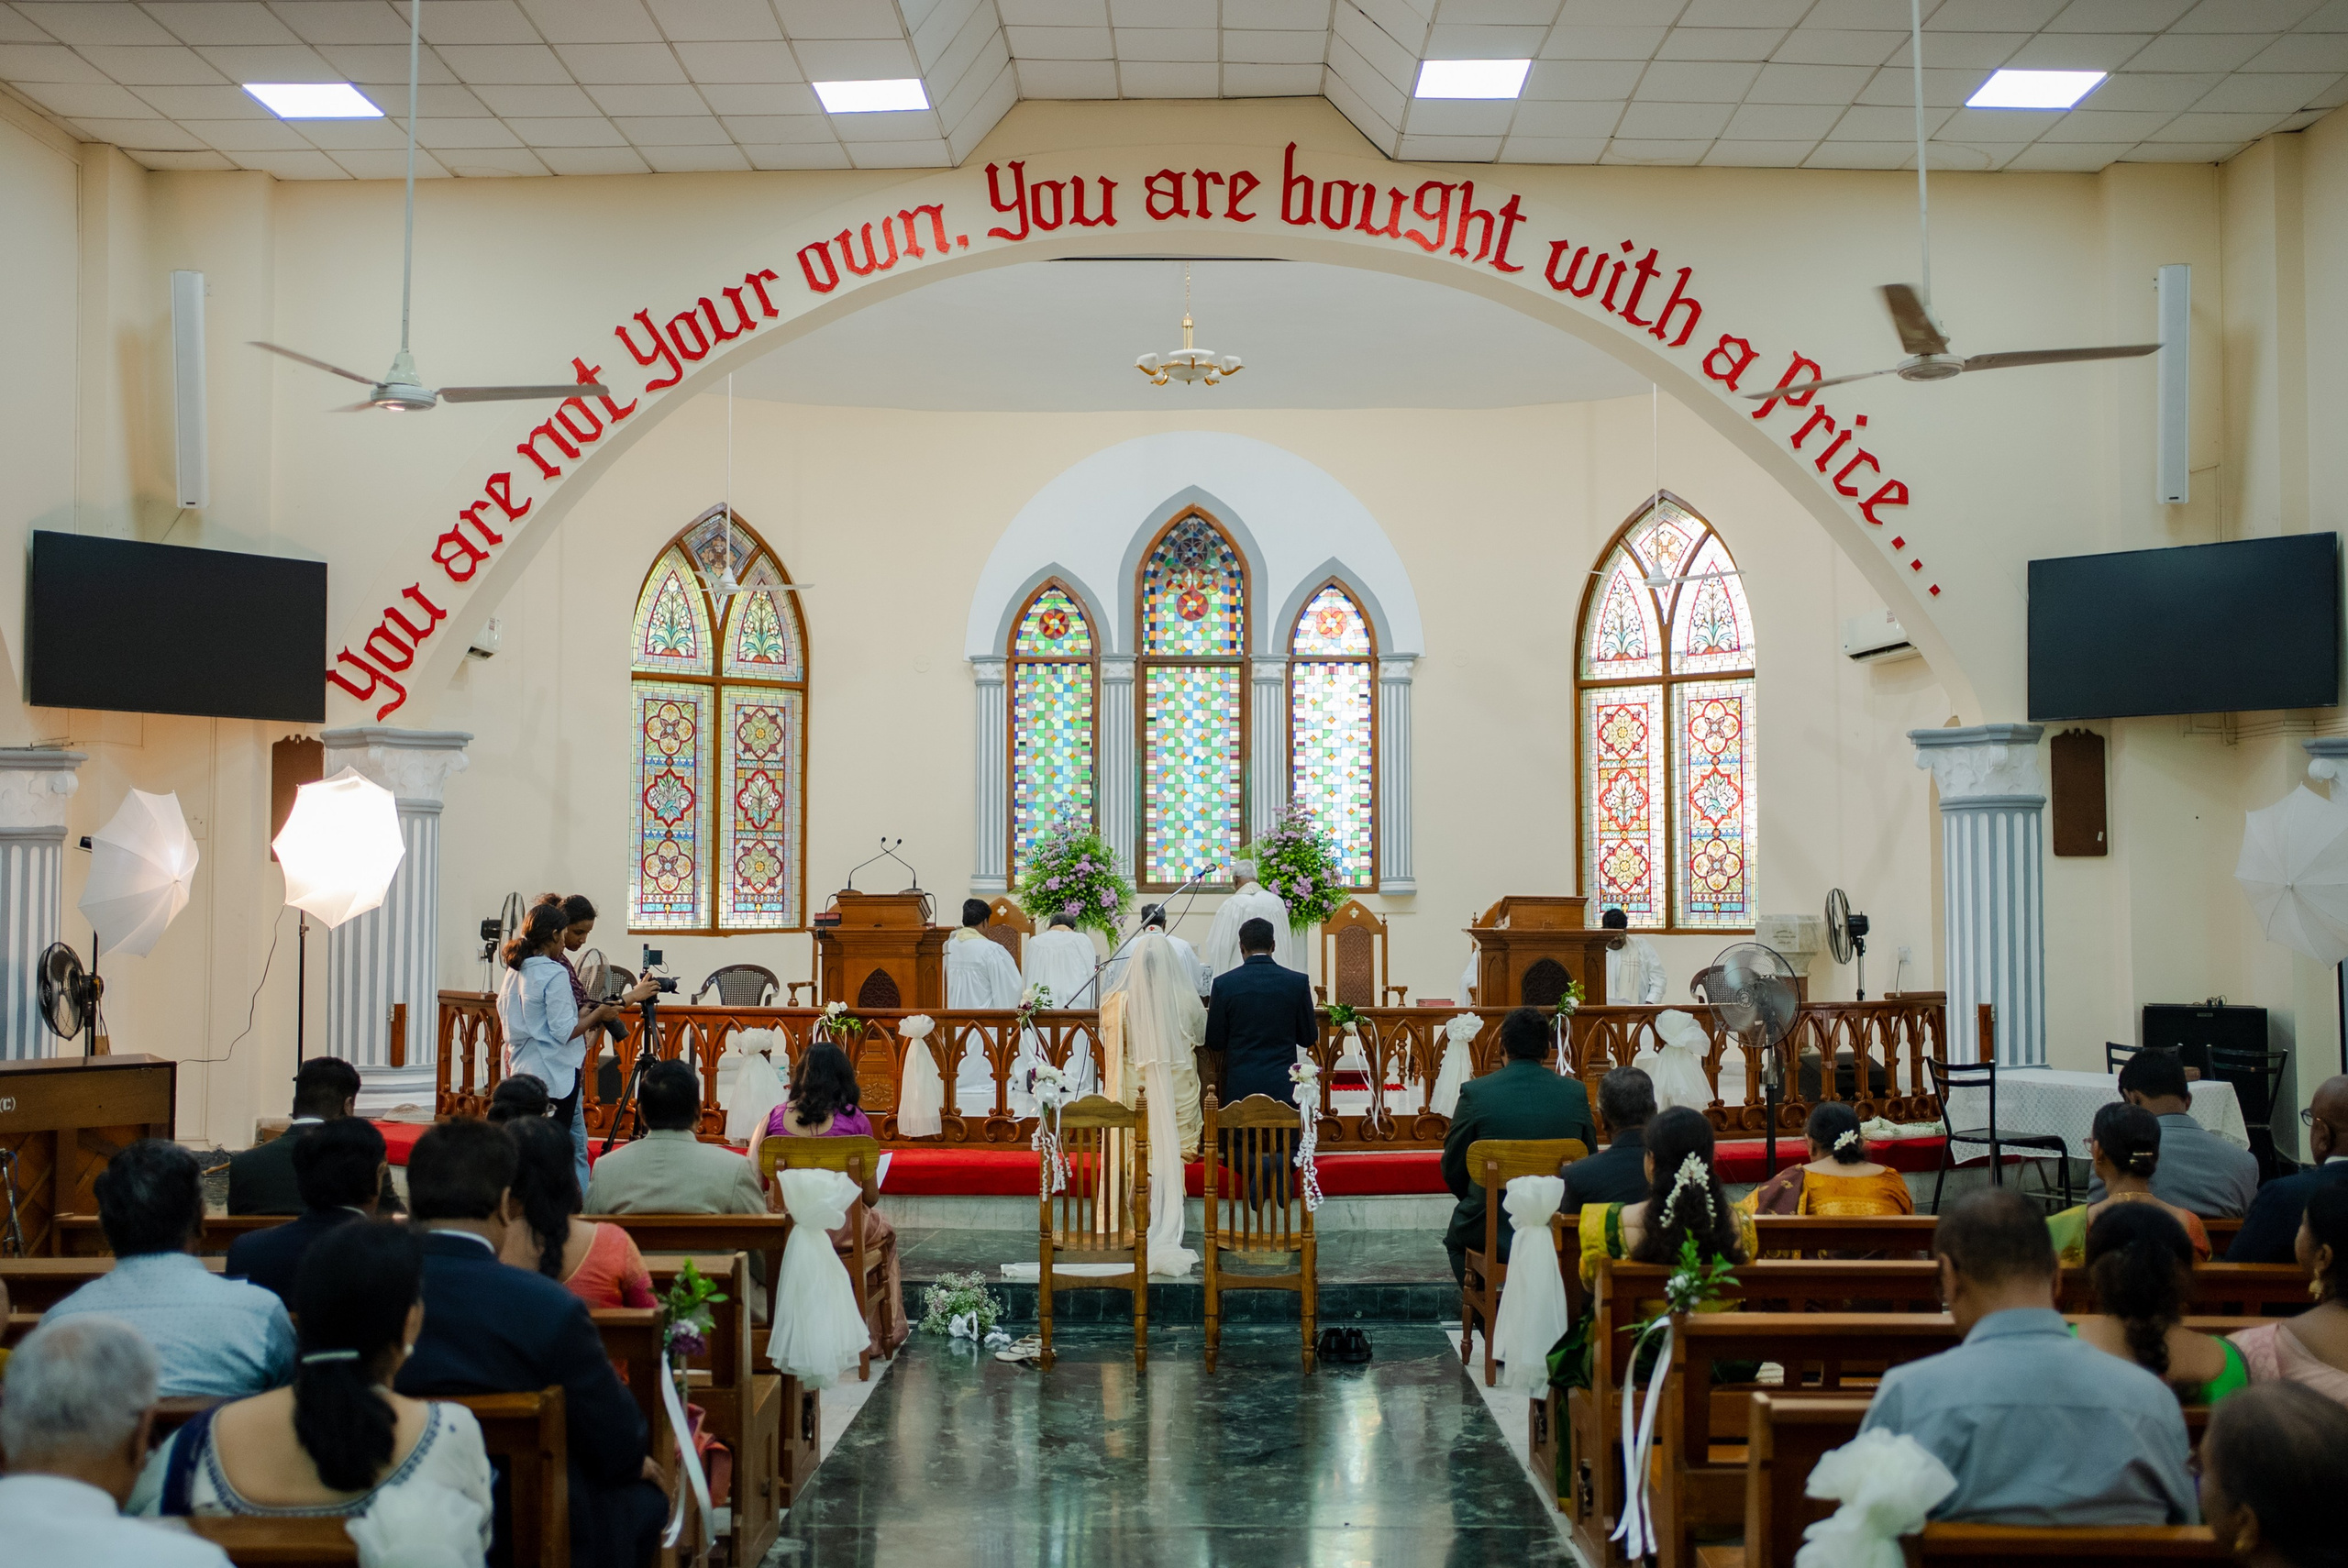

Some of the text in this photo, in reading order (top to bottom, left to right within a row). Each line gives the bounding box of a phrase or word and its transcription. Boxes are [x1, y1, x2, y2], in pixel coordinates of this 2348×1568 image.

[432, 472, 531, 581] are
[517, 358, 637, 480] not
[1145, 169, 1259, 222] are
[1281, 142, 1526, 272] bought
[1545, 240, 1701, 347] with
[1702, 334, 1759, 392] a
